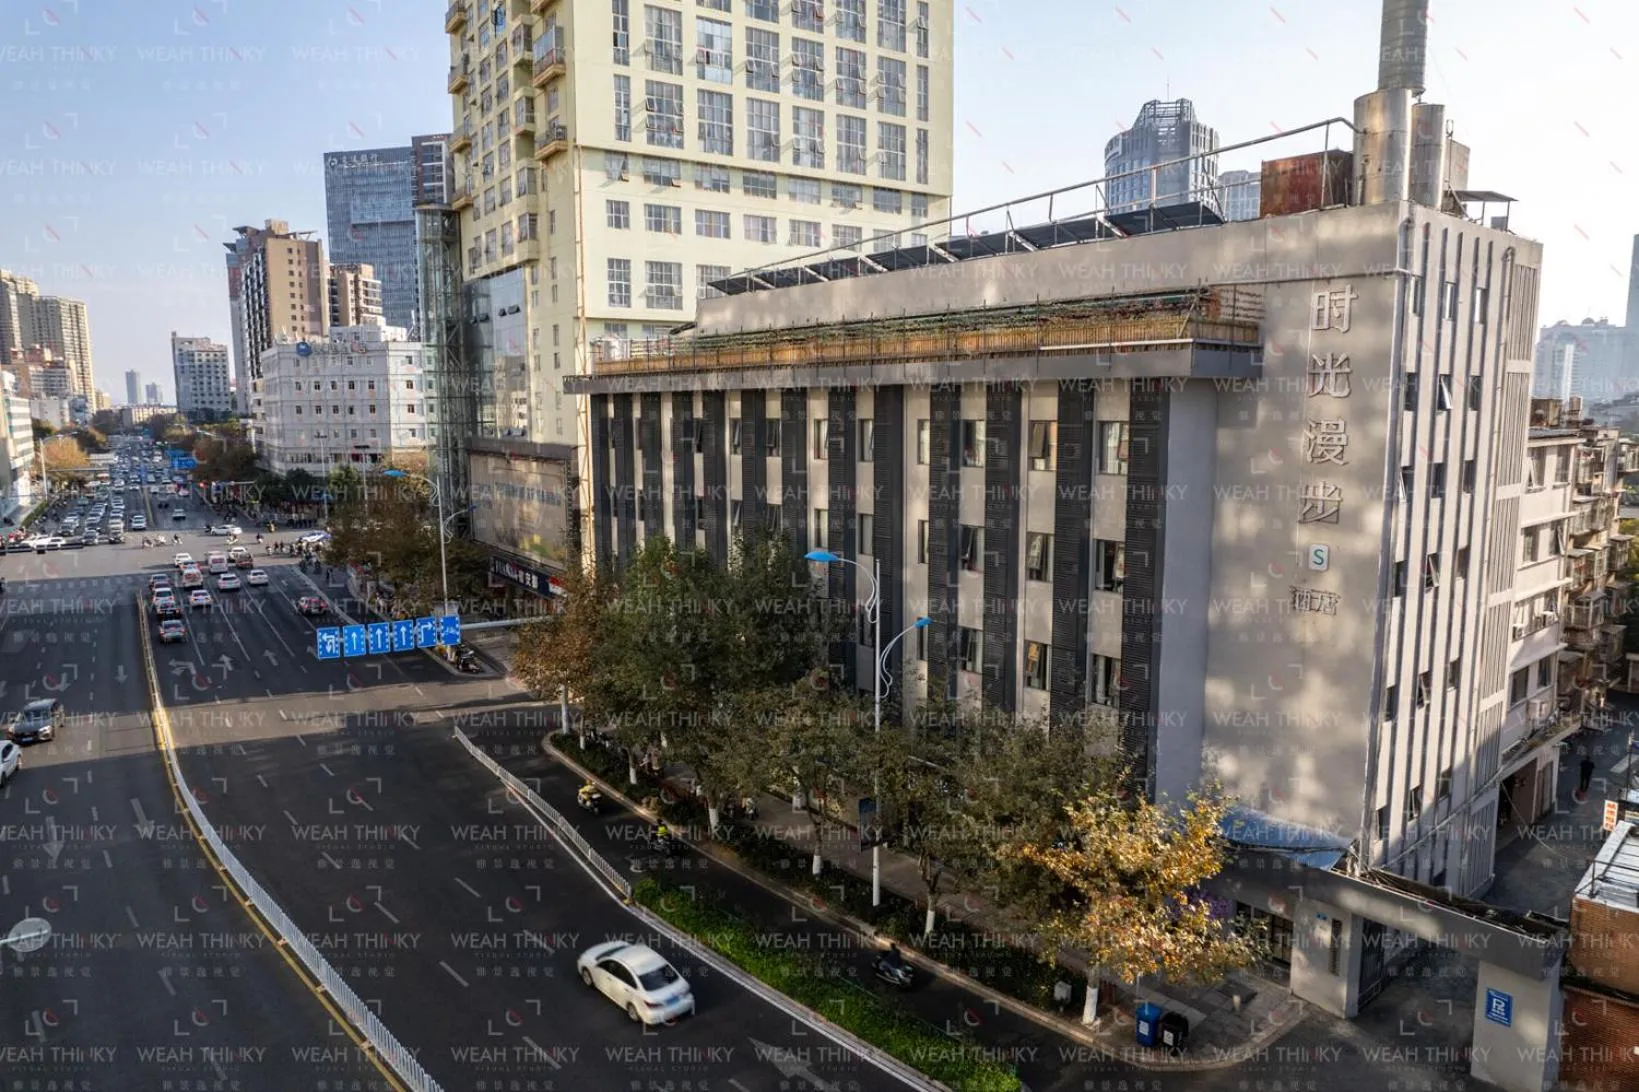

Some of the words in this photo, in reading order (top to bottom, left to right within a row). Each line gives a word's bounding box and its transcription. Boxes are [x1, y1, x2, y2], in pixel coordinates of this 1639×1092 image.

[1299, 284, 1358, 523] 时光漫步
[1313, 549, 1324, 566] S
